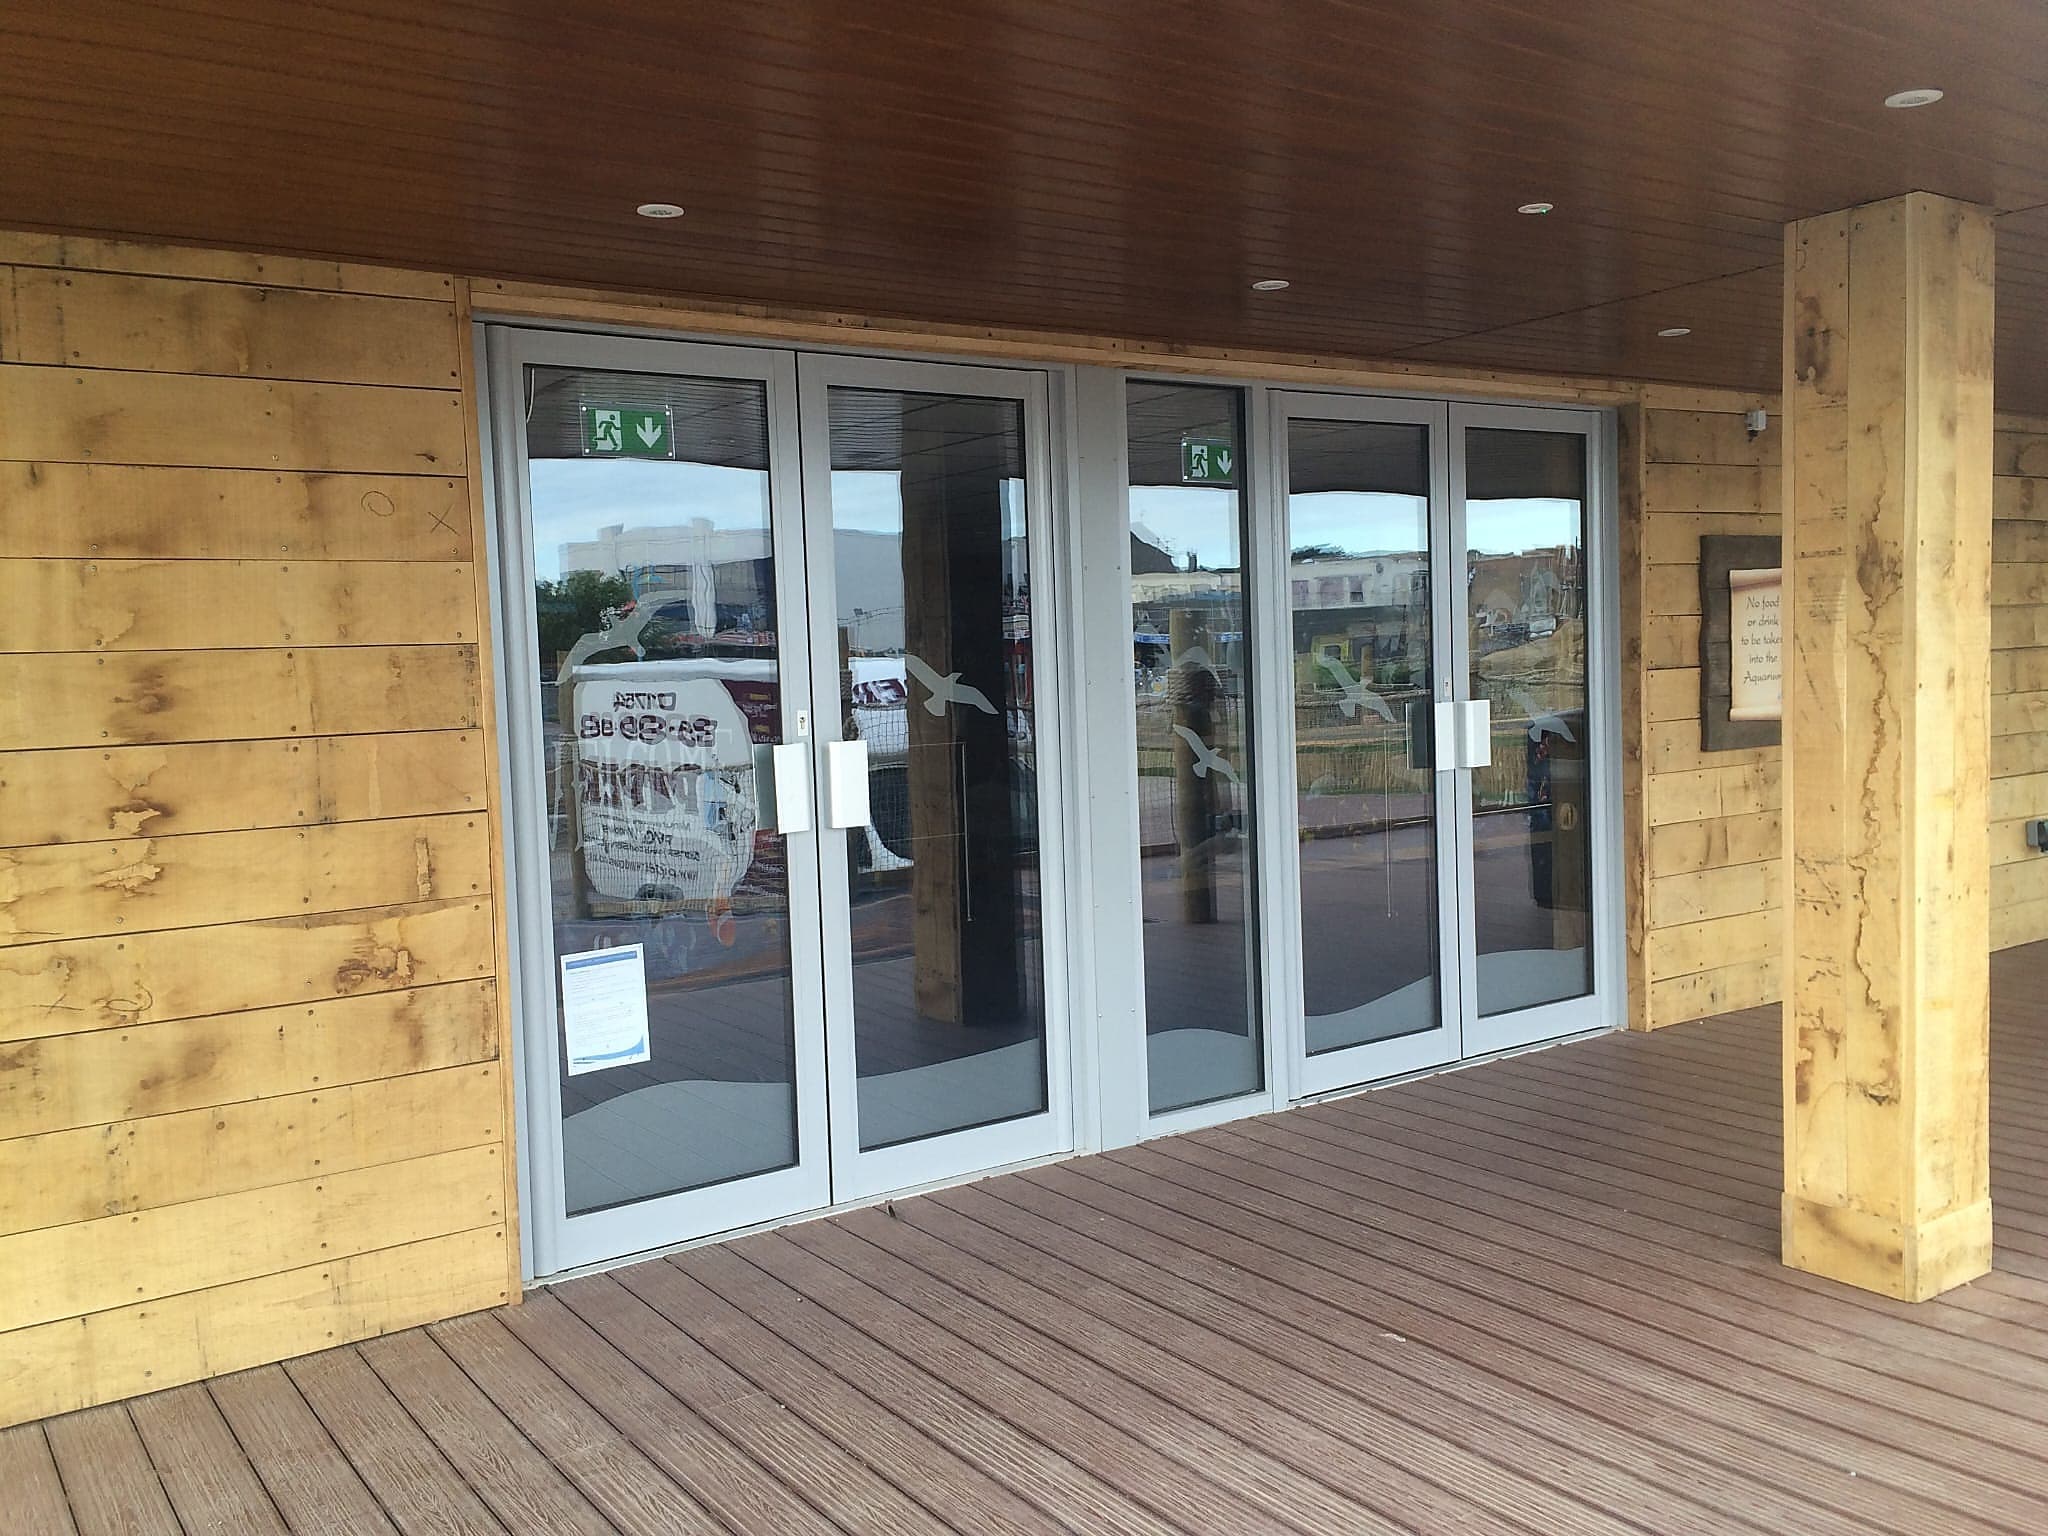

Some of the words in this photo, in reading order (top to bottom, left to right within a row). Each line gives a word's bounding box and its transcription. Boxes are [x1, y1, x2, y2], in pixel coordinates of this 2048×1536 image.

[1746, 595, 1760, 609] No
[1761, 594, 1780, 611] food
[1747, 619, 1756, 627] or
[1759, 614, 1780, 627] drink
[1741, 635, 1749, 646] to
[1751, 632, 1760, 645] be
[1749, 652, 1764, 664] into
[1765, 649, 1778, 664] the
